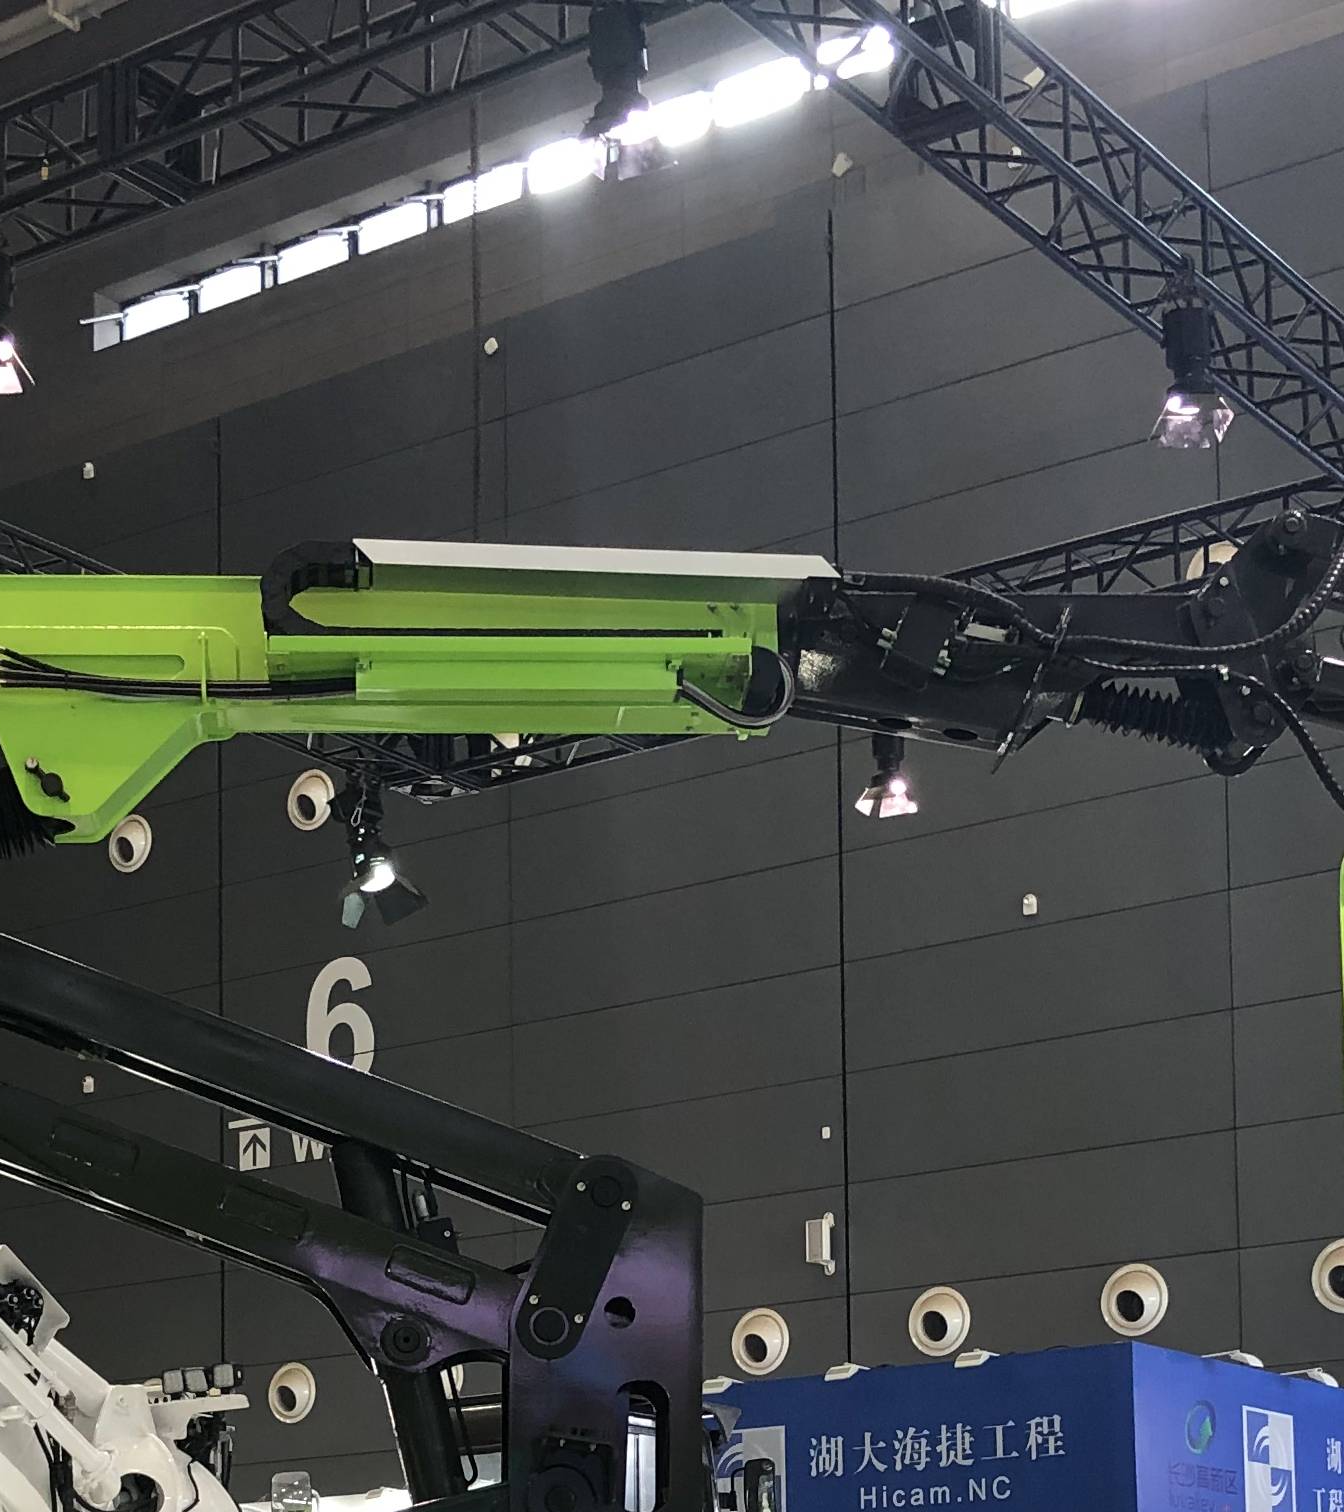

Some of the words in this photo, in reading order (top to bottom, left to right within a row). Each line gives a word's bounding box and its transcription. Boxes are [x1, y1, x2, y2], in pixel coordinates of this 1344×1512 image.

[306, 956, 375, 1073] 6
[809, 1414, 1067, 1478] 湖大海捷工程
[859, 1475, 1011, 1510] Hicam.NC
